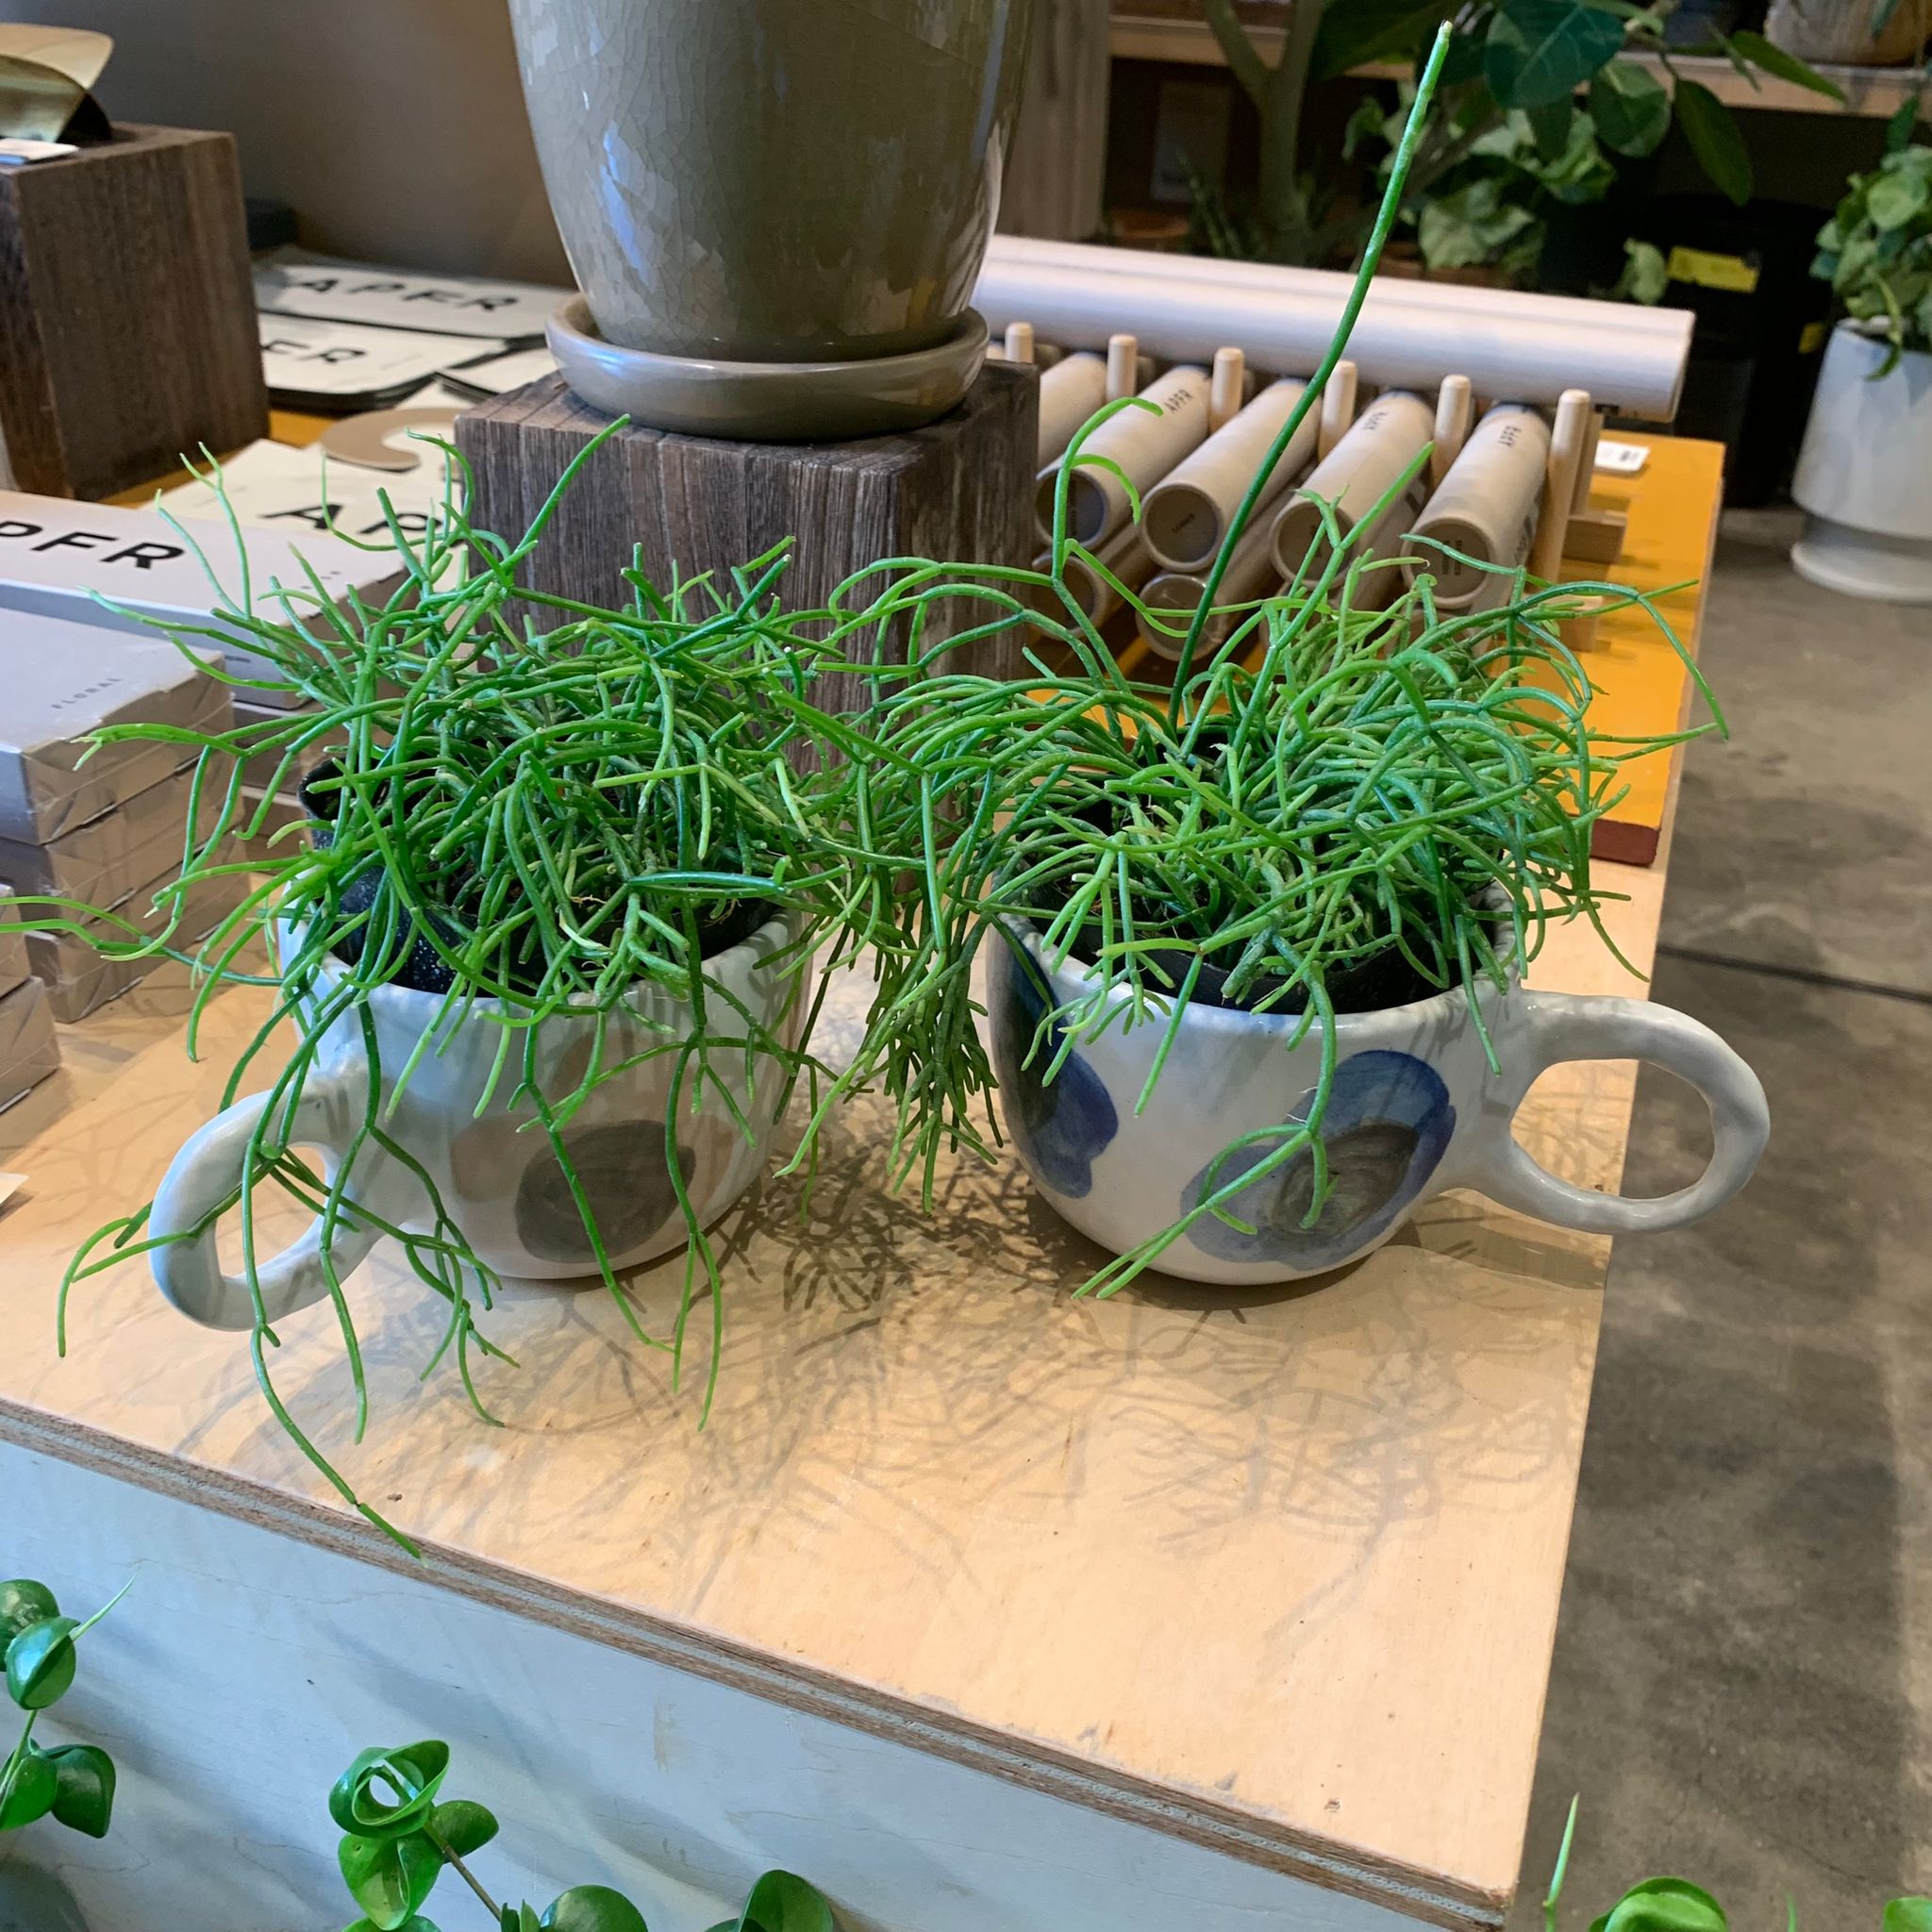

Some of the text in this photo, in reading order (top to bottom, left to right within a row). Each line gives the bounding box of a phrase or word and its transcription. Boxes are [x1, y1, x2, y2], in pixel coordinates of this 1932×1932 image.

[294, 279, 520, 312] APFR
[258, 504, 465, 547] AP
[50, 677, 124, 709] FLORAL
